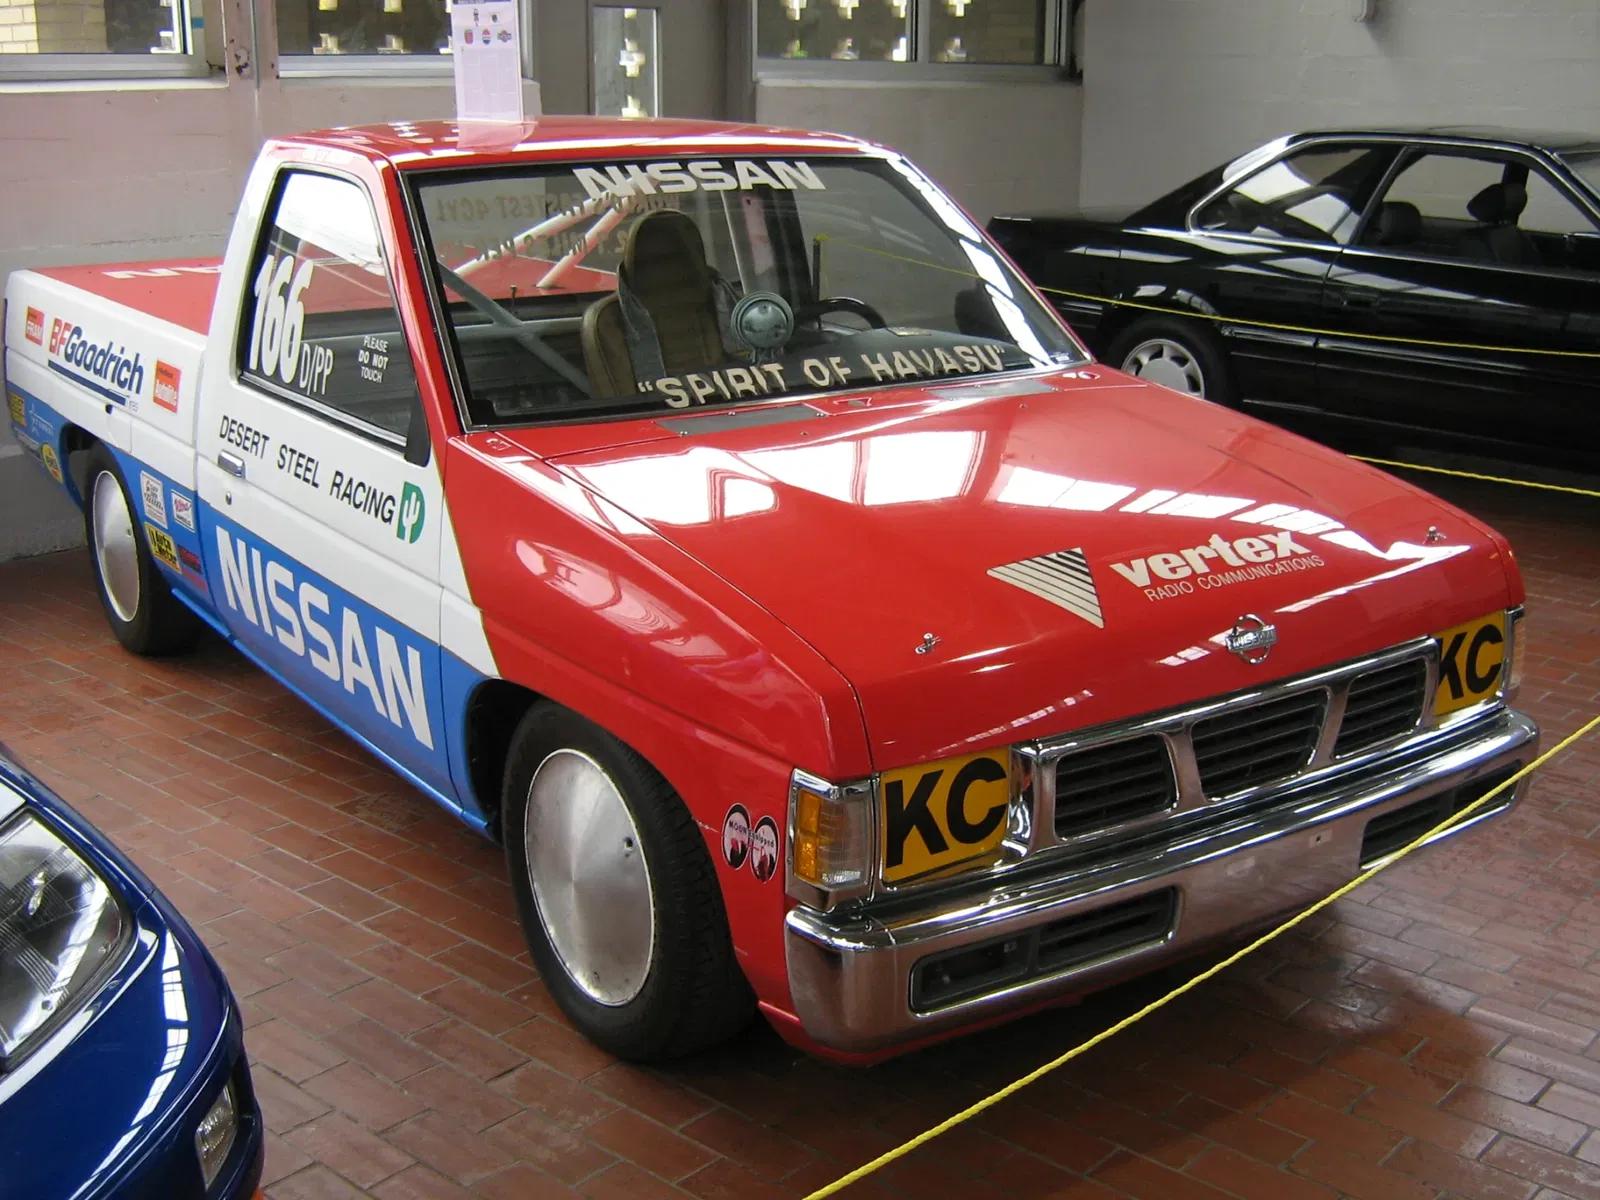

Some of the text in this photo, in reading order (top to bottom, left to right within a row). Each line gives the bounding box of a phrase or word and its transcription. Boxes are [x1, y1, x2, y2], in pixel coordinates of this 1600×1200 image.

[572, 160, 826, 197] NISSAN
[249, 254, 315, 384] 166
[363, 336, 389, 354] PLEASE
[49, 317, 145, 395] BFGoodrich
[299, 343, 334, 395] D/PP
[358, 351, 389, 369] DO NOT
[361, 366, 382, 383] TOUCH
[804, 355, 852, 388] OF
[219, 415, 396, 525] DESERT STEEL RACING
[1109, 531, 1311, 588] vertex
[1144, 555, 1325, 603] RADIO COMMUNICATIONS
[216, 525, 434, 751] NISSAN
[1438, 624, 1504, 700] KC
[885, 757, 1008, 869] KC
